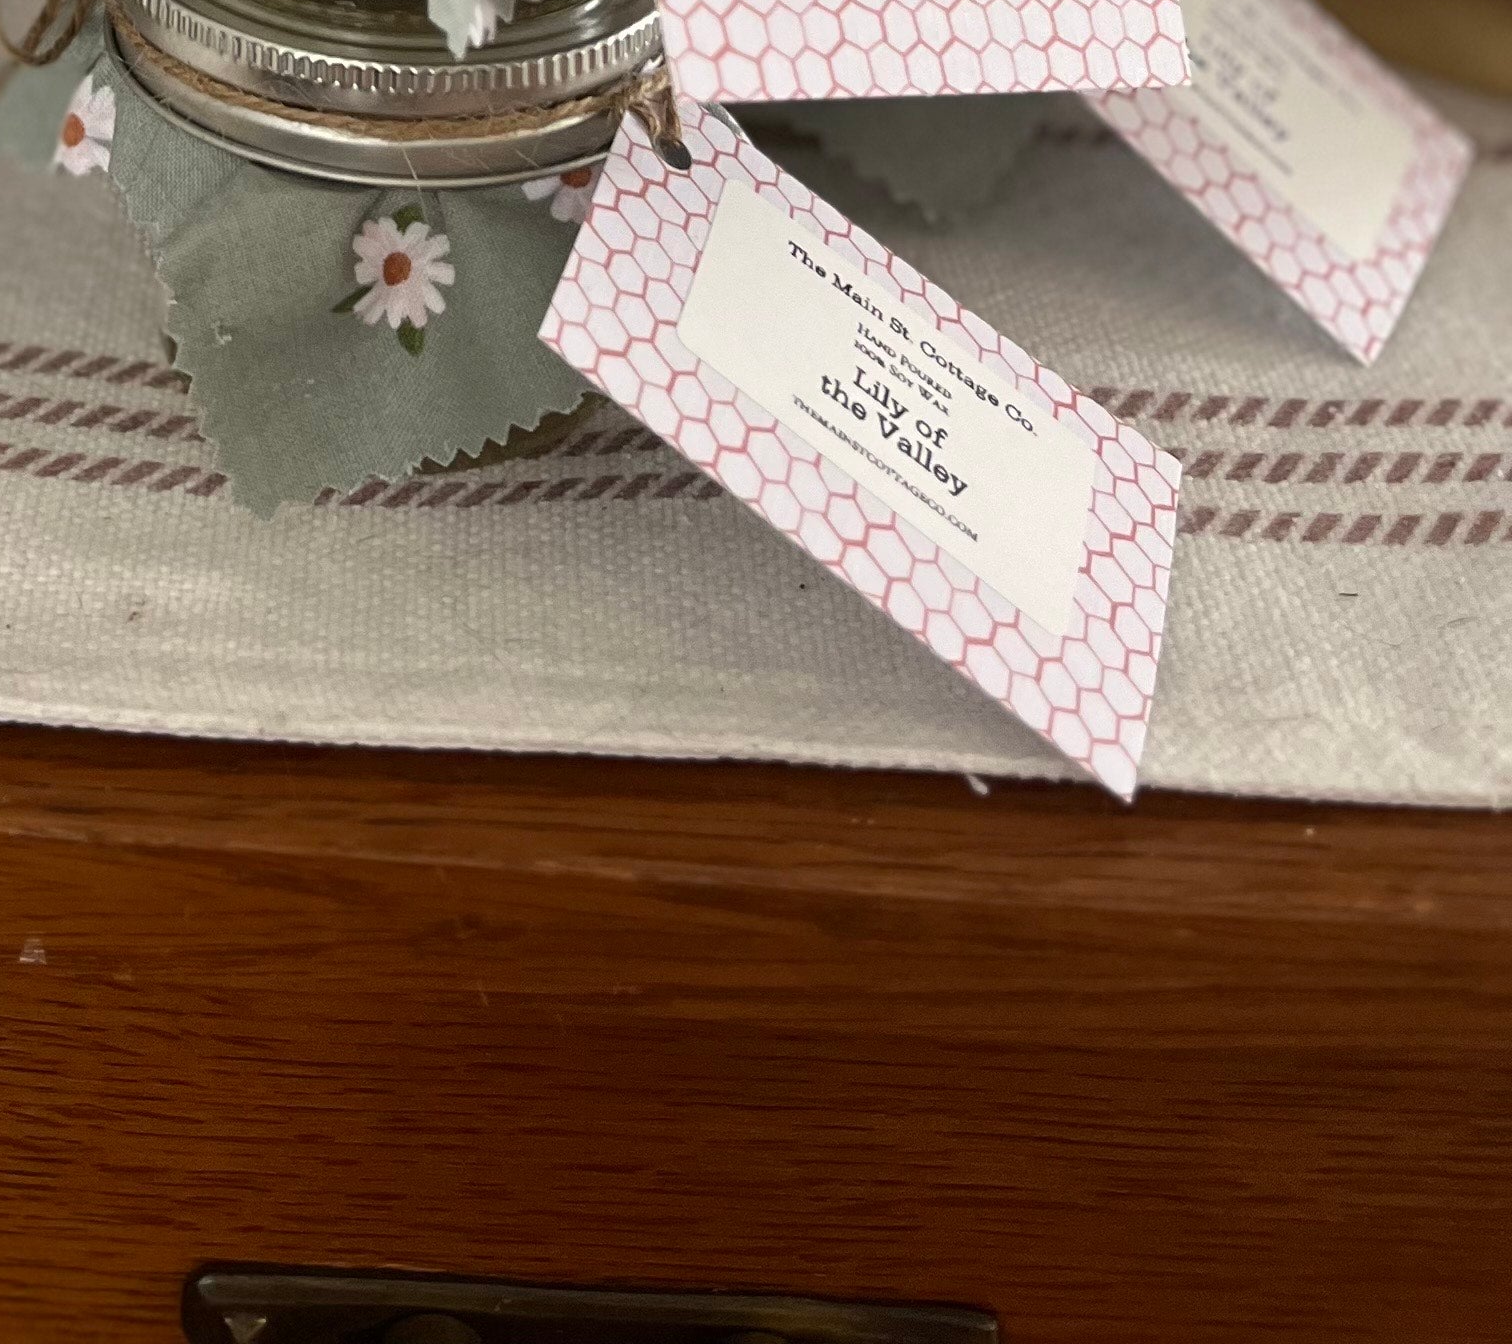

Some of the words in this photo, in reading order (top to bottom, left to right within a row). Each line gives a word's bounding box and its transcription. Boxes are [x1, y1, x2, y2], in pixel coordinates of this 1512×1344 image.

[788, 240, 827, 278] The
[831, 272, 884, 321] Main
[890, 317, 913, 344] St.
[920, 341, 1000, 407] Cottage
[1005, 403, 1040, 437] Co.
[821, 376, 867, 420] the
[876, 413, 969, 497] Valley
[853, 365, 909, 419] Lily
[916, 420, 948, 451] of
